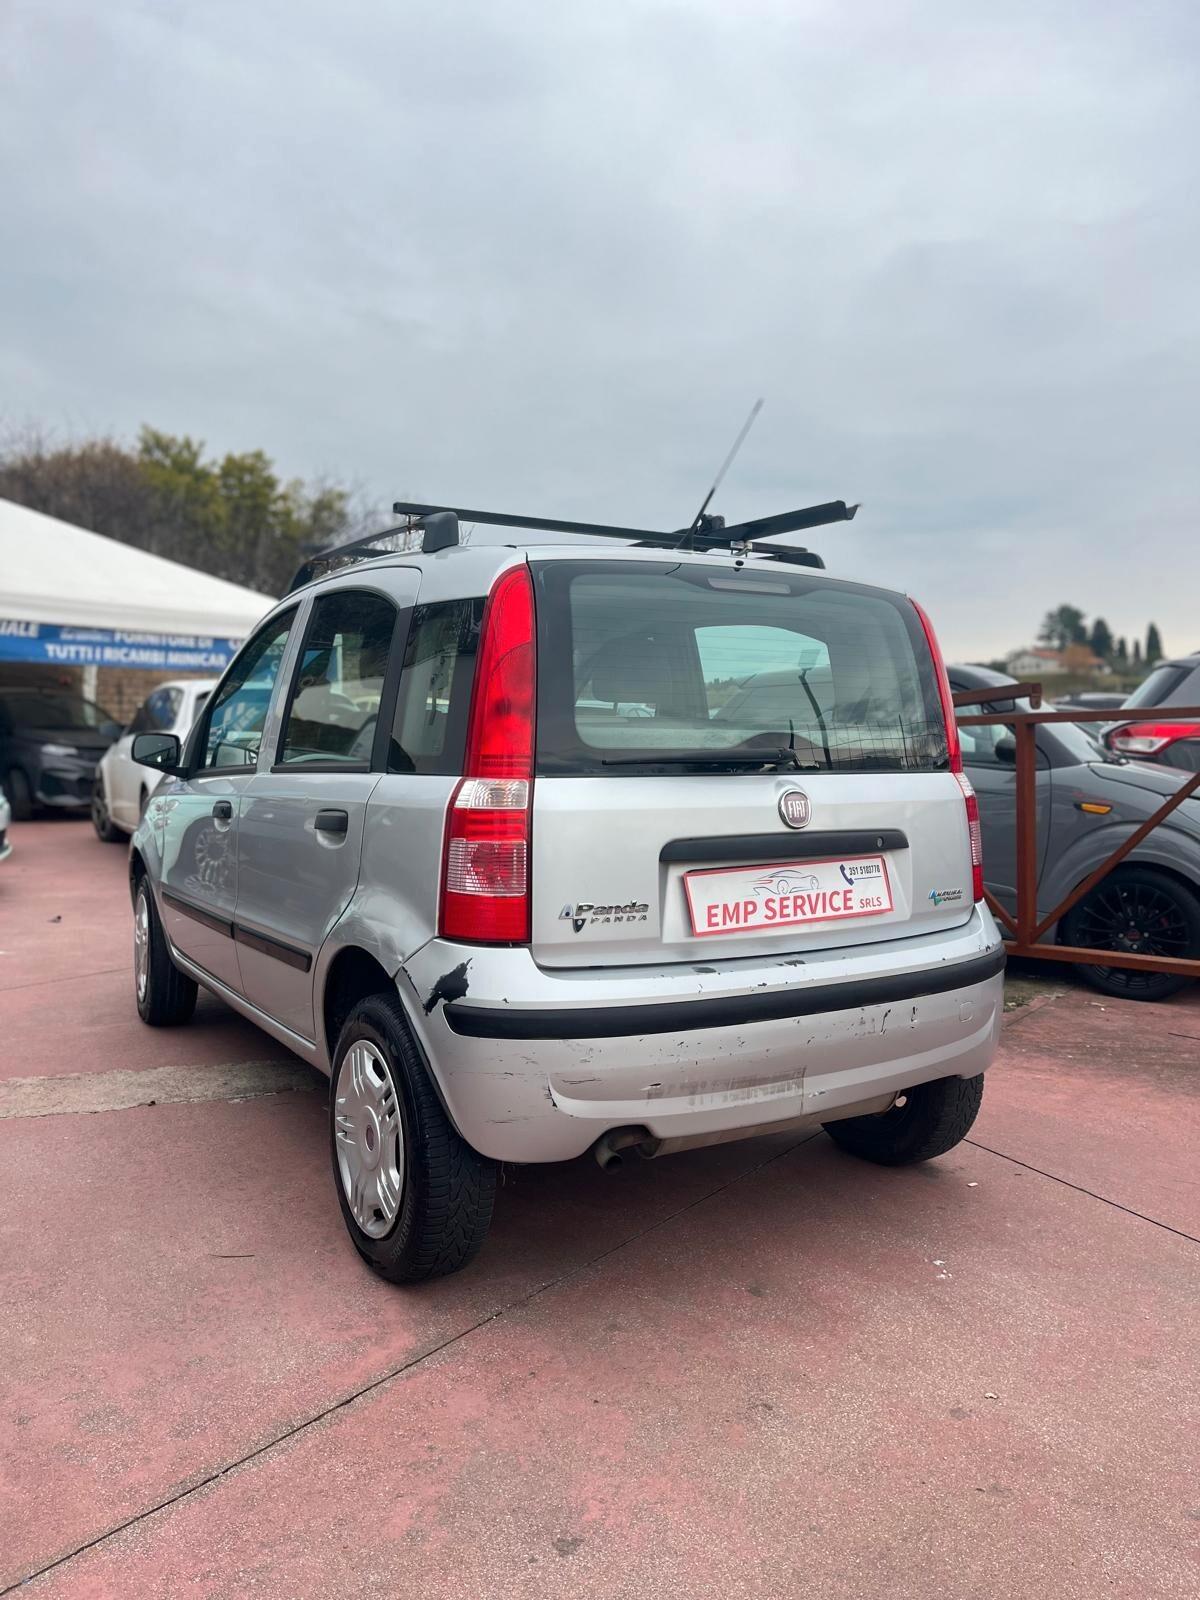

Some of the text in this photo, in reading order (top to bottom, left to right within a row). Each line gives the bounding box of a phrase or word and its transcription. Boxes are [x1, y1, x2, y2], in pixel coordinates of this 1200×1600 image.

[45, 643, 93, 660] TUTTI
[103, 647, 165, 664] RICAMBI
[167, 652, 227, 668] MINICAR
[787, 800, 805, 818] FIAT
[849, 866, 859, 876] 351
[575, 900, 649, 916] Panda
[707, 889, 882, 927] EMP SERVICE SRLS
[590, 914, 648, 924] PANDA
